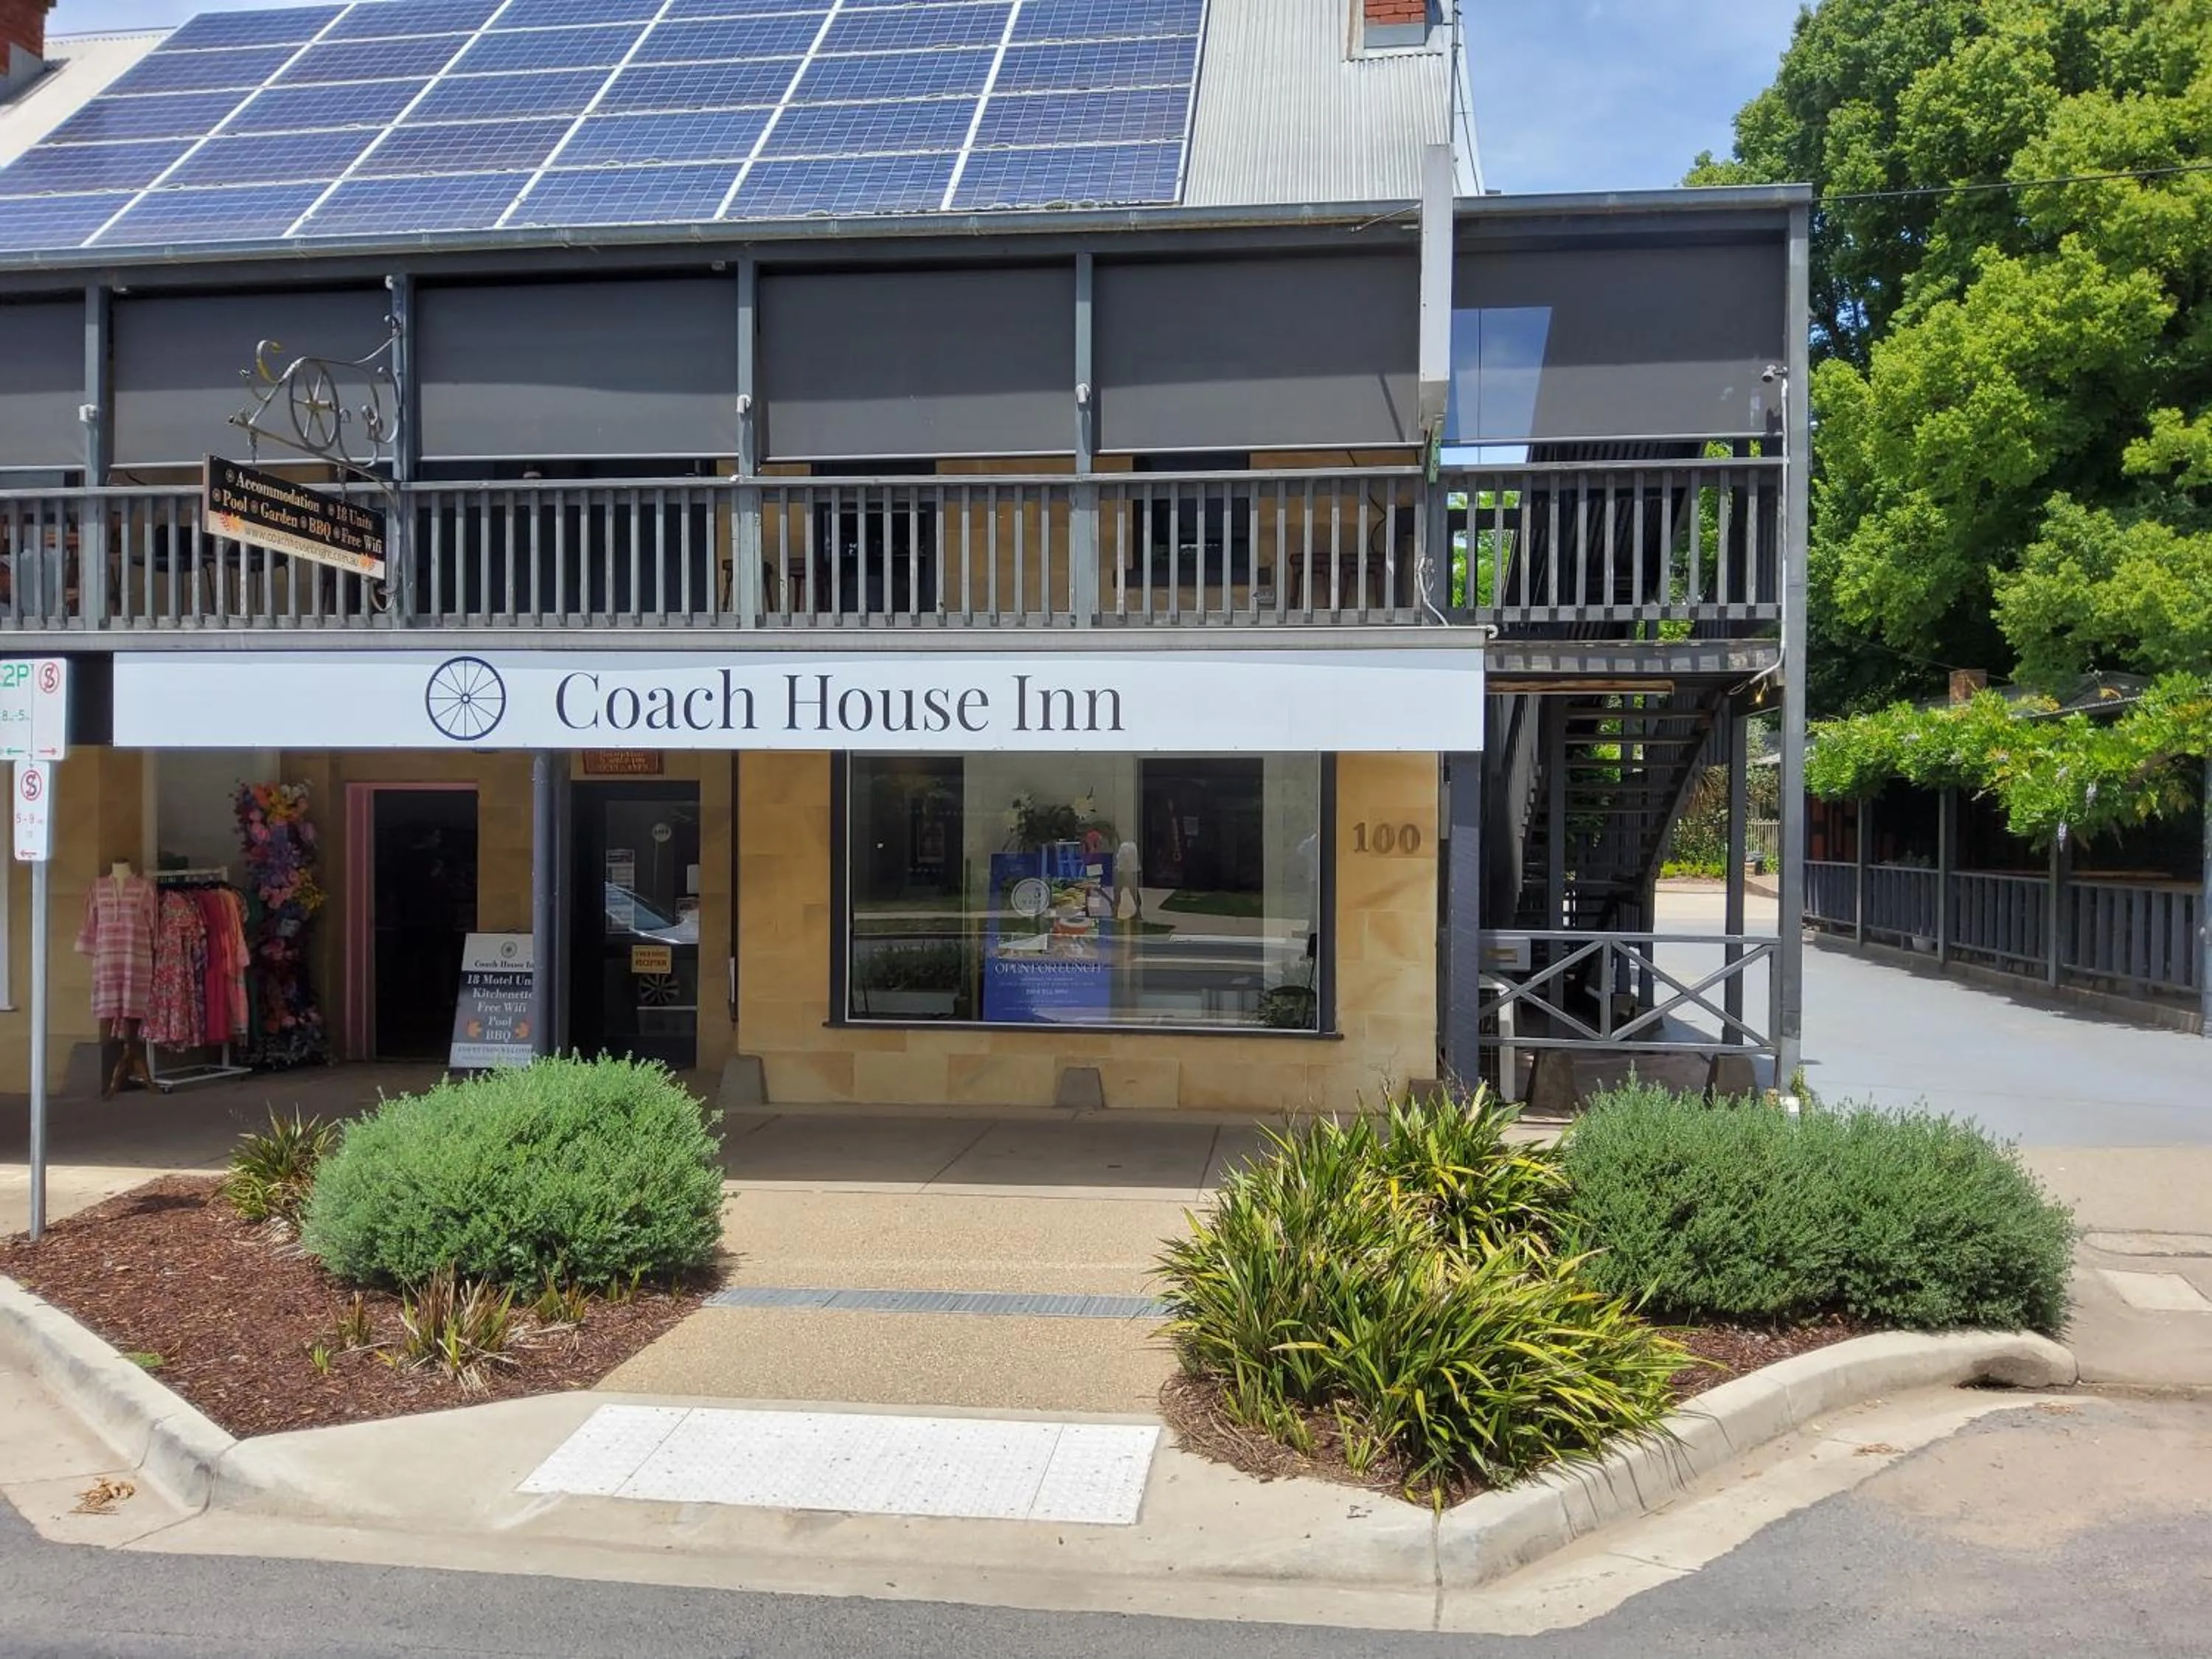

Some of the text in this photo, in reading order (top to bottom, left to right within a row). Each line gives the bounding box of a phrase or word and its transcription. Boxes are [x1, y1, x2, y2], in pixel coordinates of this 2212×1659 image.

[235, 471, 372, 529] Accommodation 18 Units
[222, 489, 382, 554] Pool Garden BBQ Free Wifi
[1, 664, 29, 687] 2P
[556, 668, 1126, 732] Coach House Inn
[1352, 821, 1421, 855] 100
[474, 960, 498, 968] Coach
[995, 962, 1029, 974] OPEN
[1032, 962, 1057, 974] FOR
[482, 975, 512, 985] Motel
[477, 1002, 526, 1013] Free Wifi
[489, 1016, 512, 1027] Pool
[485, 1030, 512, 1043] BBQ
